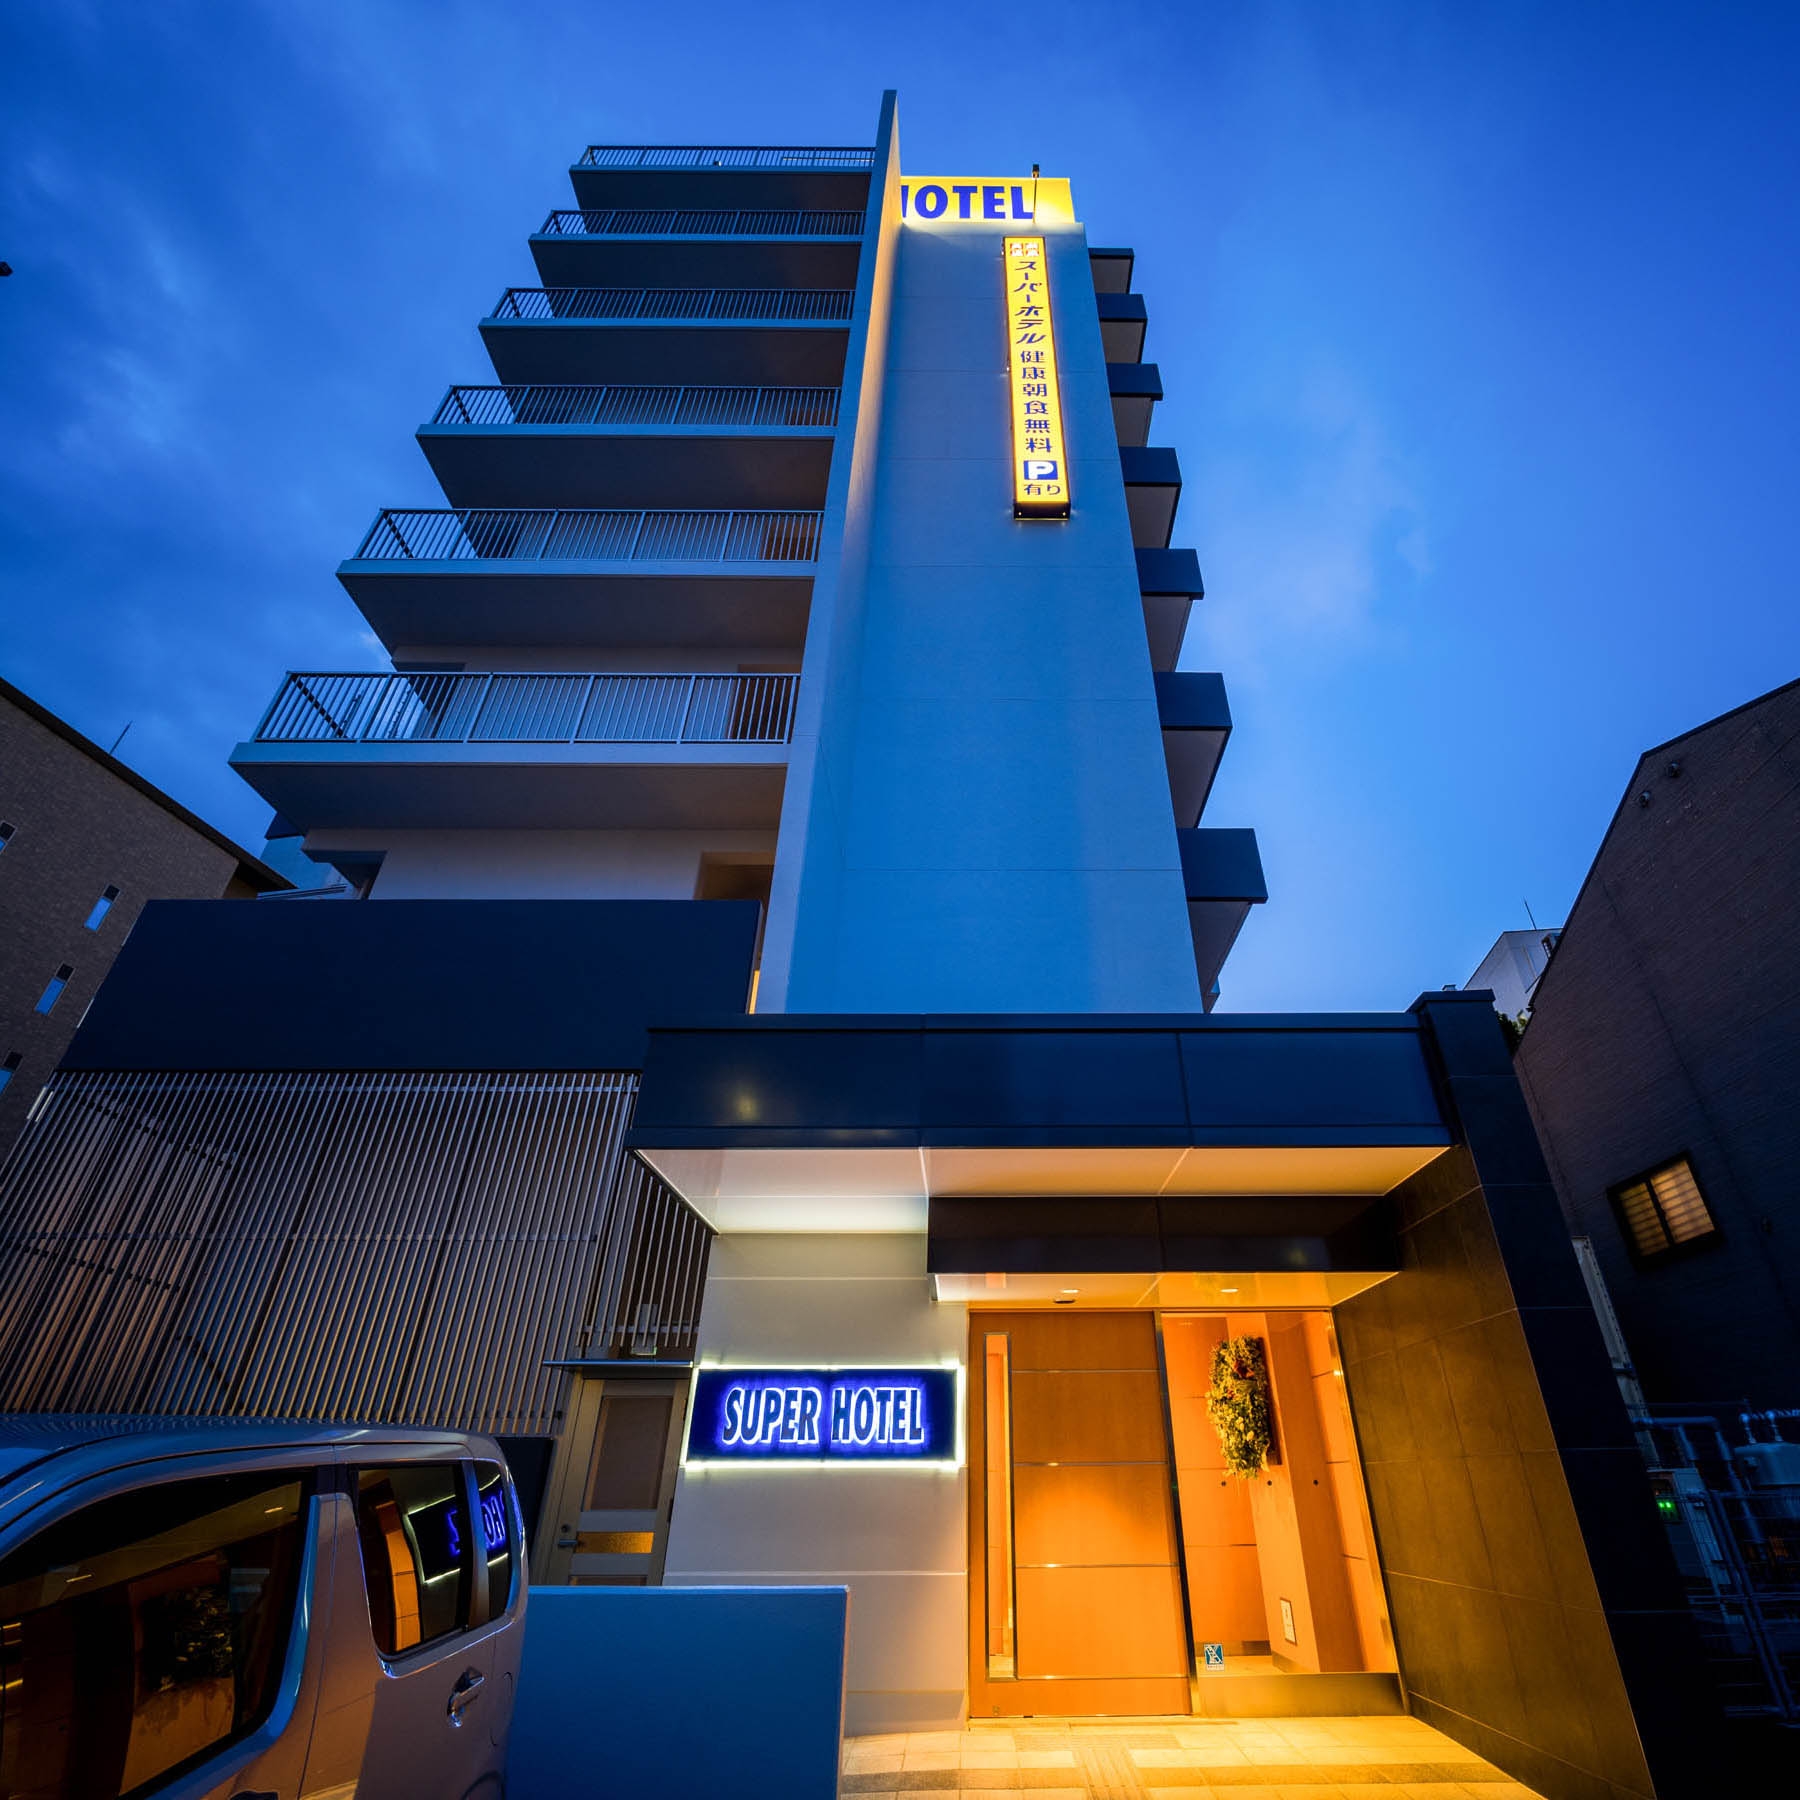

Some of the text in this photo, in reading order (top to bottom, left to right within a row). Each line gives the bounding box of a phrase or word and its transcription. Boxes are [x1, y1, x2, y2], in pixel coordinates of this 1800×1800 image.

[1014, 260, 1047, 345] スーパーホテル
[1020, 350, 1053, 453] 健康朝食無料
[1023, 483, 1061, 496] 有り
[721, 1386, 925, 1445] SUPER HOTEL
